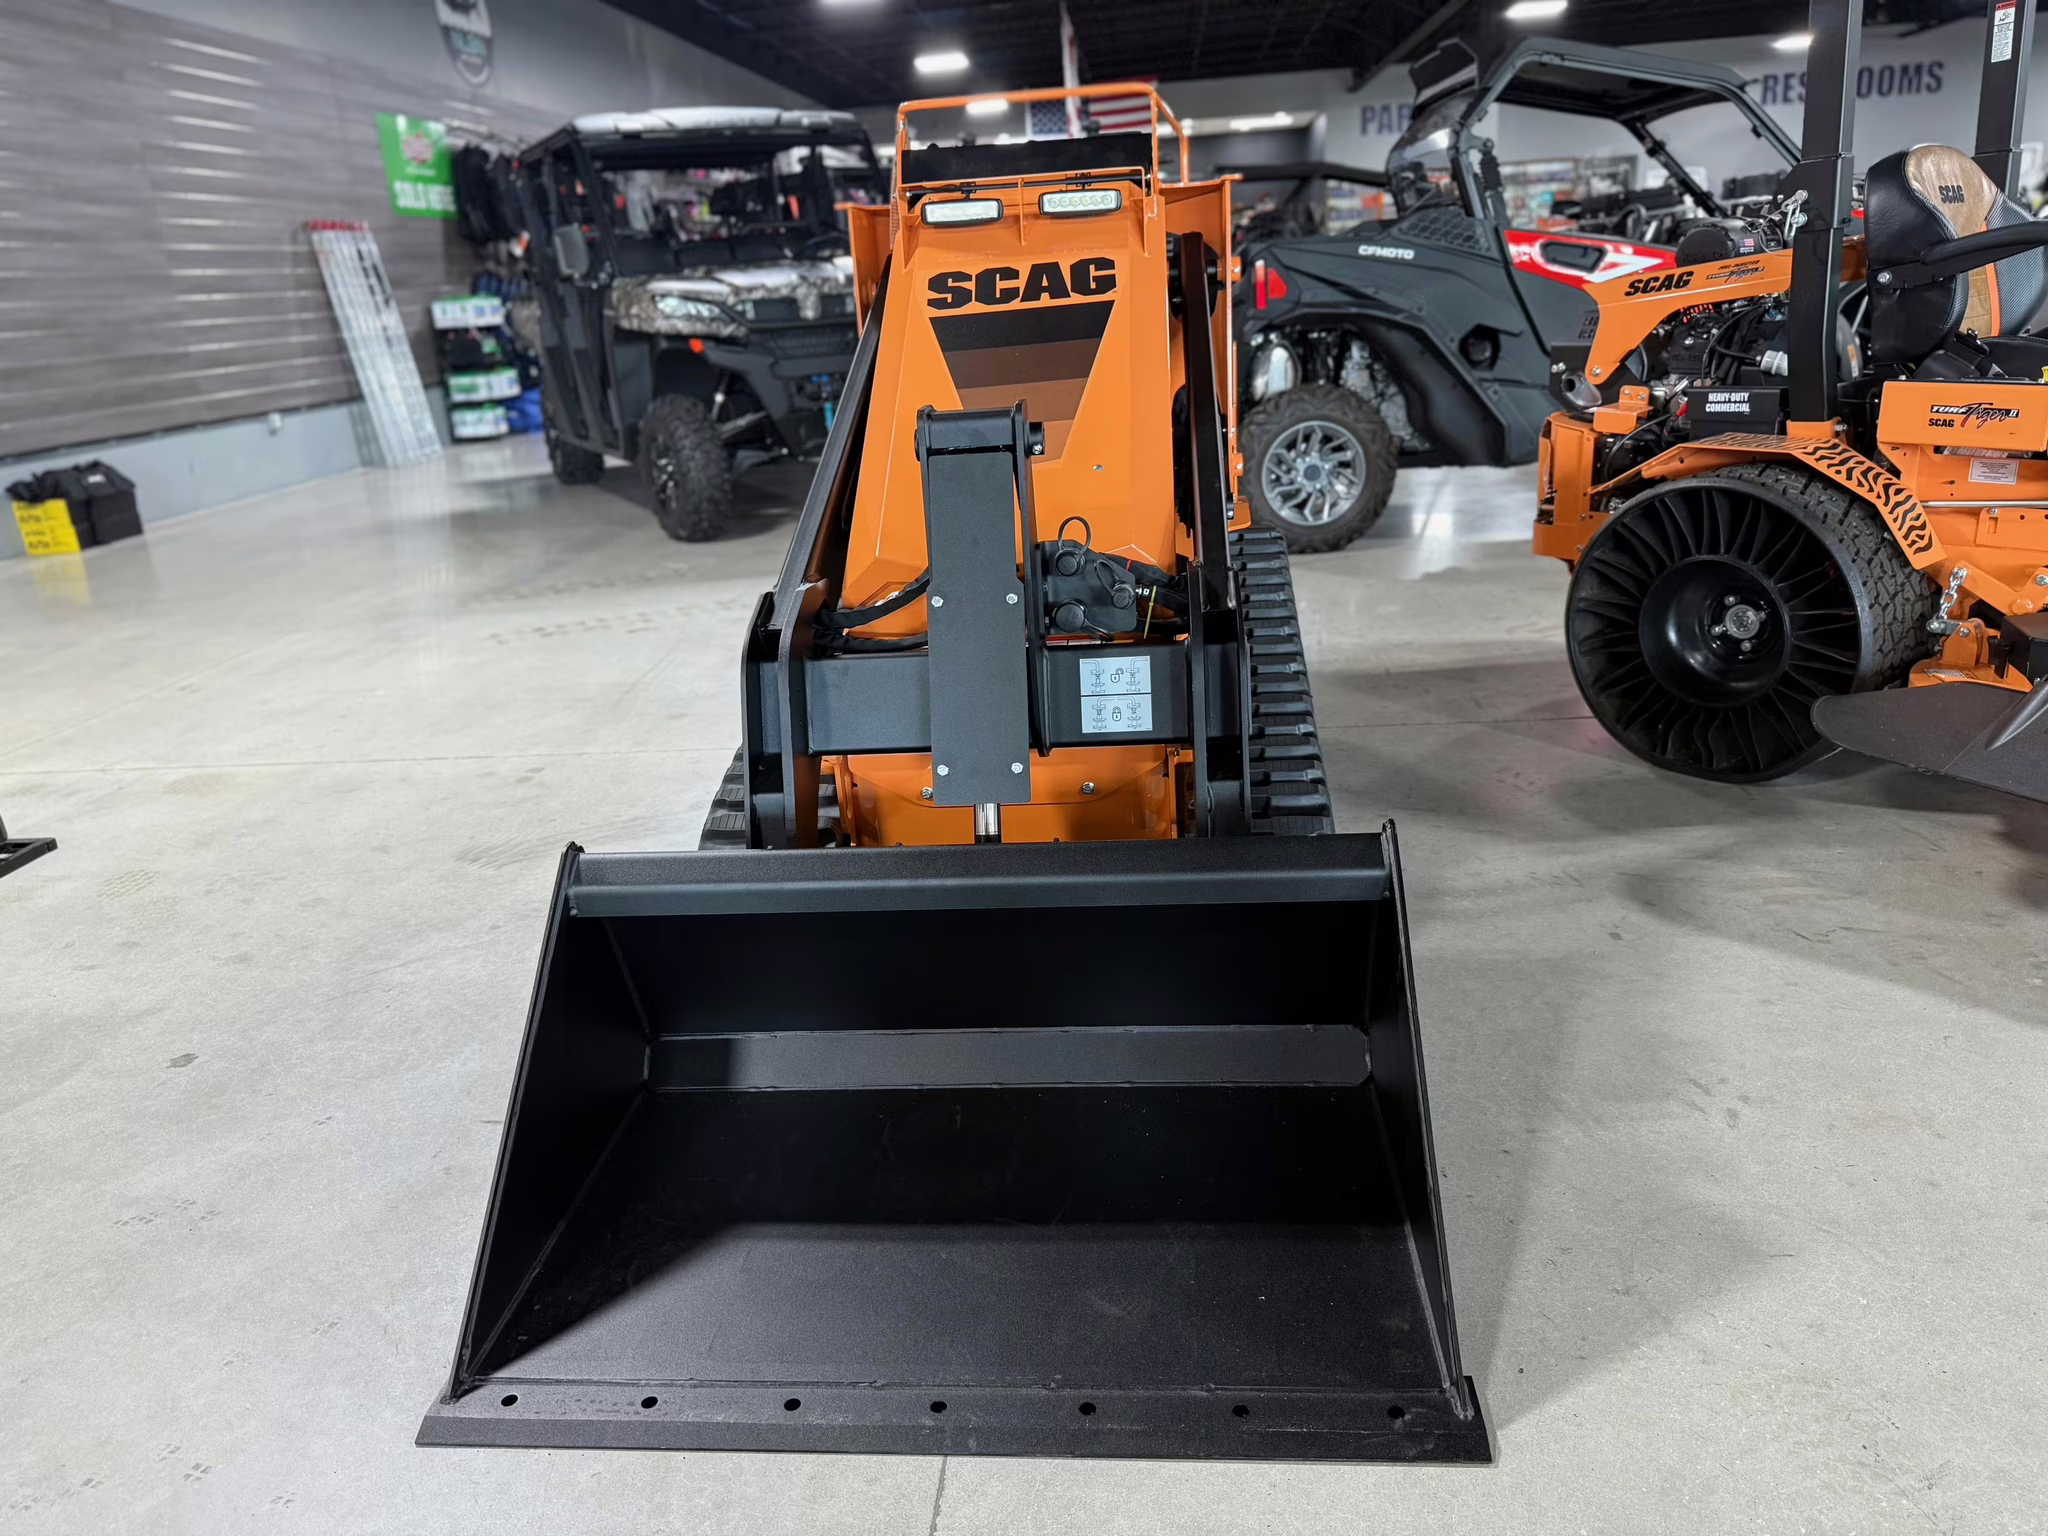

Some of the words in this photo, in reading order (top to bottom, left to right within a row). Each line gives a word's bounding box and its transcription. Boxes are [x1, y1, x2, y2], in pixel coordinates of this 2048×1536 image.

[1762, 61, 1945, 104] REOOMS
[1938, 184, 1965, 204] SCAG
[1358, 244, 1415, 260] CFMOTO
[927, 257, 1117, 310] SCAG
[1624, 271, 1694, 297] SCAG
[1708, 392, 1750, 402] HEAVY-DUTY
[1705, 403, 1750, 412] COMMERCIAL
[1931, 405, 1969, 414] TURF
[1960, 402, 2007, 429] Tiger
[1928, 418, 1955, 428] SCAG
